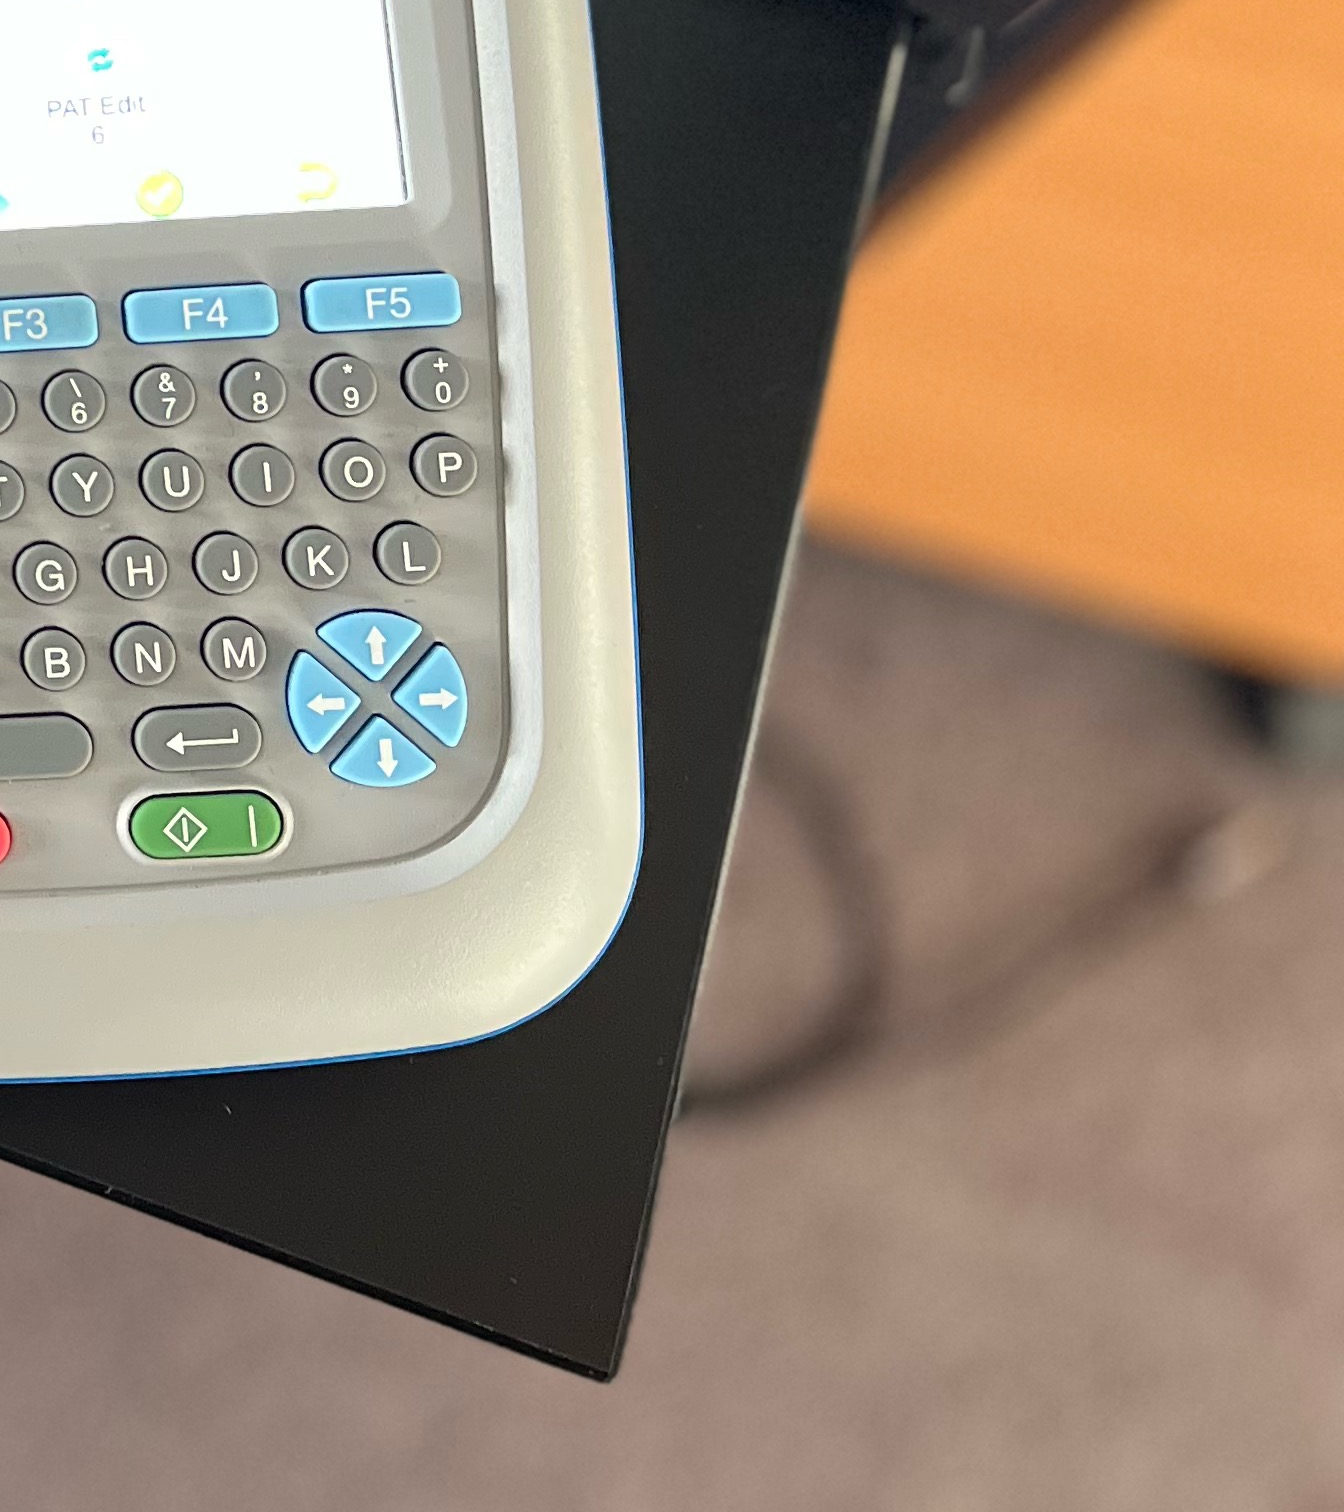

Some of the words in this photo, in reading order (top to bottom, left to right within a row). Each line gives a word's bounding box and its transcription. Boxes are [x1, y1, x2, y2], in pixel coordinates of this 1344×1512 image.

[46, 97, 92, 119] PAT
[100, 94, 147, 116] Edit
[91, 124, 105, 145] 6
[182, 297, 229, 330] F4
[365, 287, 412, 320] F5
[2, 308, 48, 341] F3
[160, 397, 177, 419] 7
[252, 391, 269, 414] 8
[343, 386, 360, 409] 9
[435, 381, 452, 404] 0
[71, 402, 88, 424] 6
[163, 465, 190, 498] U
[263, 461, 272, 493] I
[344, 456, 374, 488] O
[438, 452, 463, 483] P
[72, 471, 99, 503] Y
[126, 555, 154, 587] H
[221, 549, 241, 582] J
[306, 544, 335, 577] K
[402, 541, 427, 572] L
[35, 559, 65, 592] G
[44, 647, 71, 679] B
[134, 641, 162, 674] N
[222, 636, 256, 669] M
